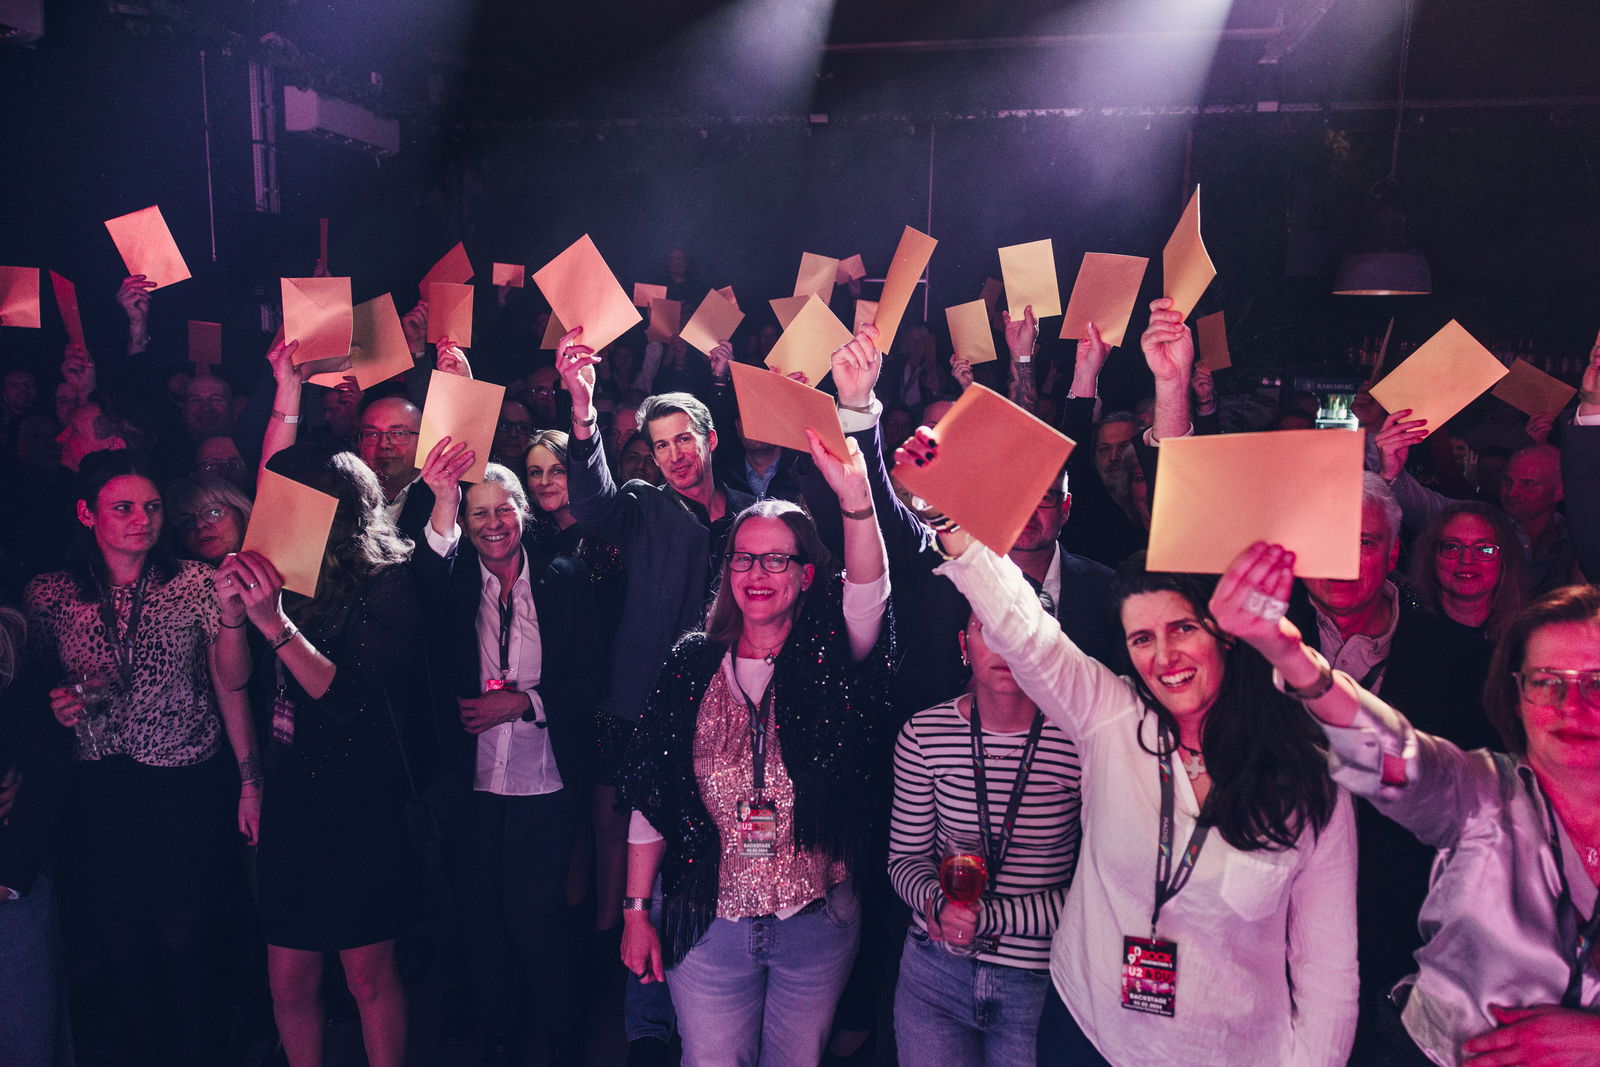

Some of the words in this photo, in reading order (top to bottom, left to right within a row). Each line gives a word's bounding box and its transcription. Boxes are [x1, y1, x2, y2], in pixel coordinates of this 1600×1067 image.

[742, 823, 753, 831] U2
[1128, 966, 1143, 978] U2
[1145, 969, 1152, 978] &
[1154, 971, 1170, 982] DU
[1129, 992, 1167, 1005] BACKSTAGE
